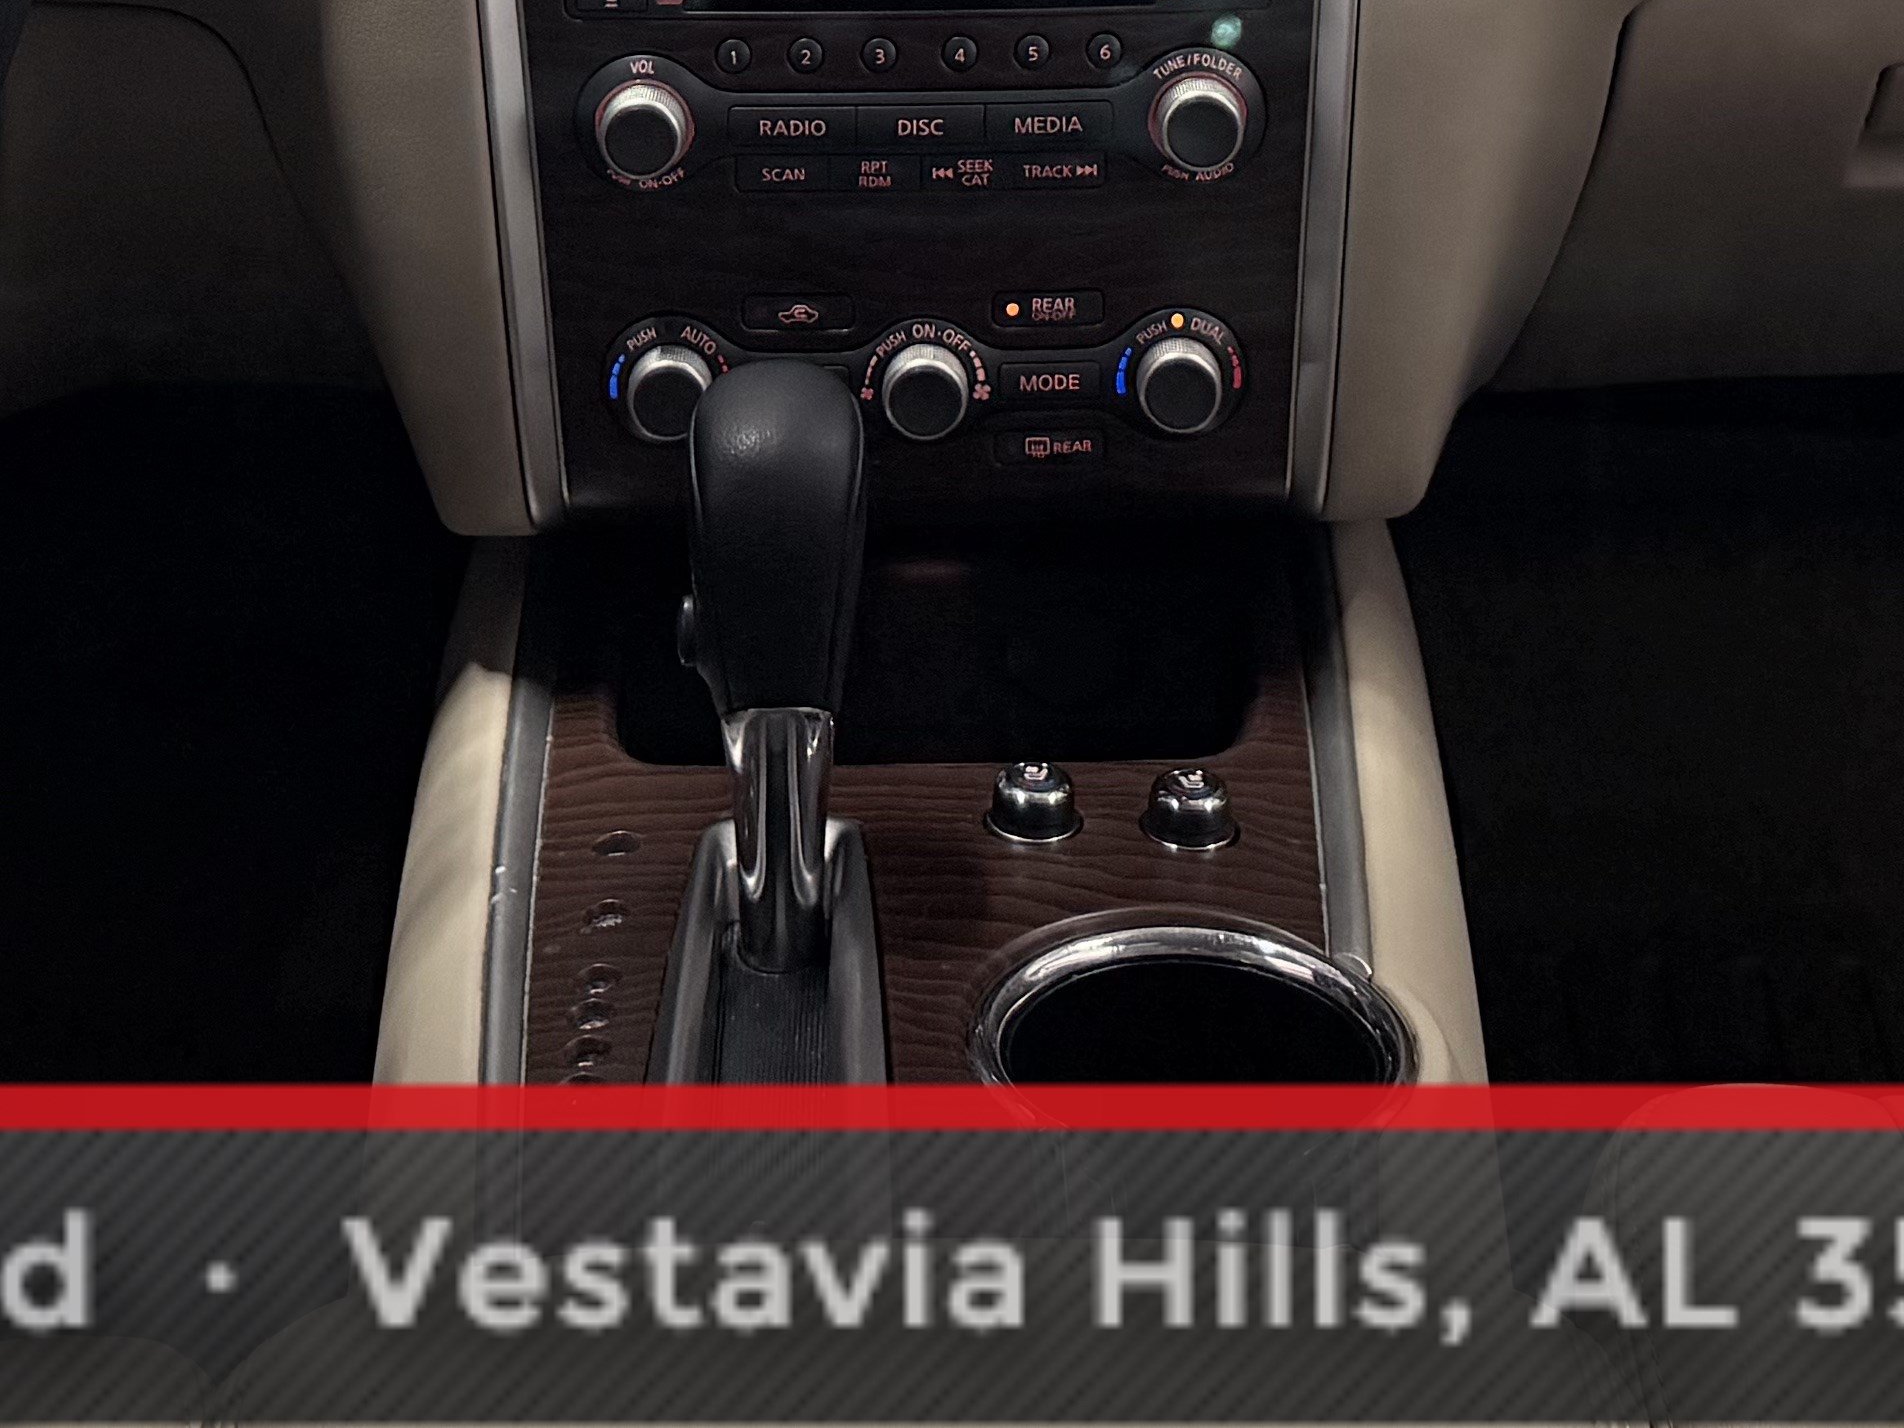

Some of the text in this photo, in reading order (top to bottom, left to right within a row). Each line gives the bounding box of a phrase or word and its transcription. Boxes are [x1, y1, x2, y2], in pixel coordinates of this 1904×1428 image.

[729, 48, 738, 66] 1
[799, 48, 813, 66] 2
[874, 48, 886, 66] 3
[953, 46, 967, 65] 4
[1027, 45, 1039, 63] 5
[1099, 44, 1112, 62] 6
[630, 59, 655, 75] VOL
[1153, 52, 1244, 81] TUNE/FOLDER
[759, 119, 827, 137] RADIO
[897, 118, 944, 136] DISC
[1014, 115, 1083, 134] MEDIA
[762, 167, 806, 182] SCAN
[860, 160, 888, 174] RPT
[957, 159, 993, 174] SEEK
[1023, 164, 1073, 179] TRACK
[1195, 162, 1235, 182] AUDIO
[859, 175, 892, 188] RDM
[961, 173, 990, 187] CAT
[1032, 296, 1076, 313] REAR
[1136, 317, 1225, 345] PUSH DUAL
[626, 326, 716, 355] PUSH AUTO
[875, 331, 907, 358] PUSH
[1019, 373, 1081, 392] MODE
[1053, 439, 1093, 454] REAR
